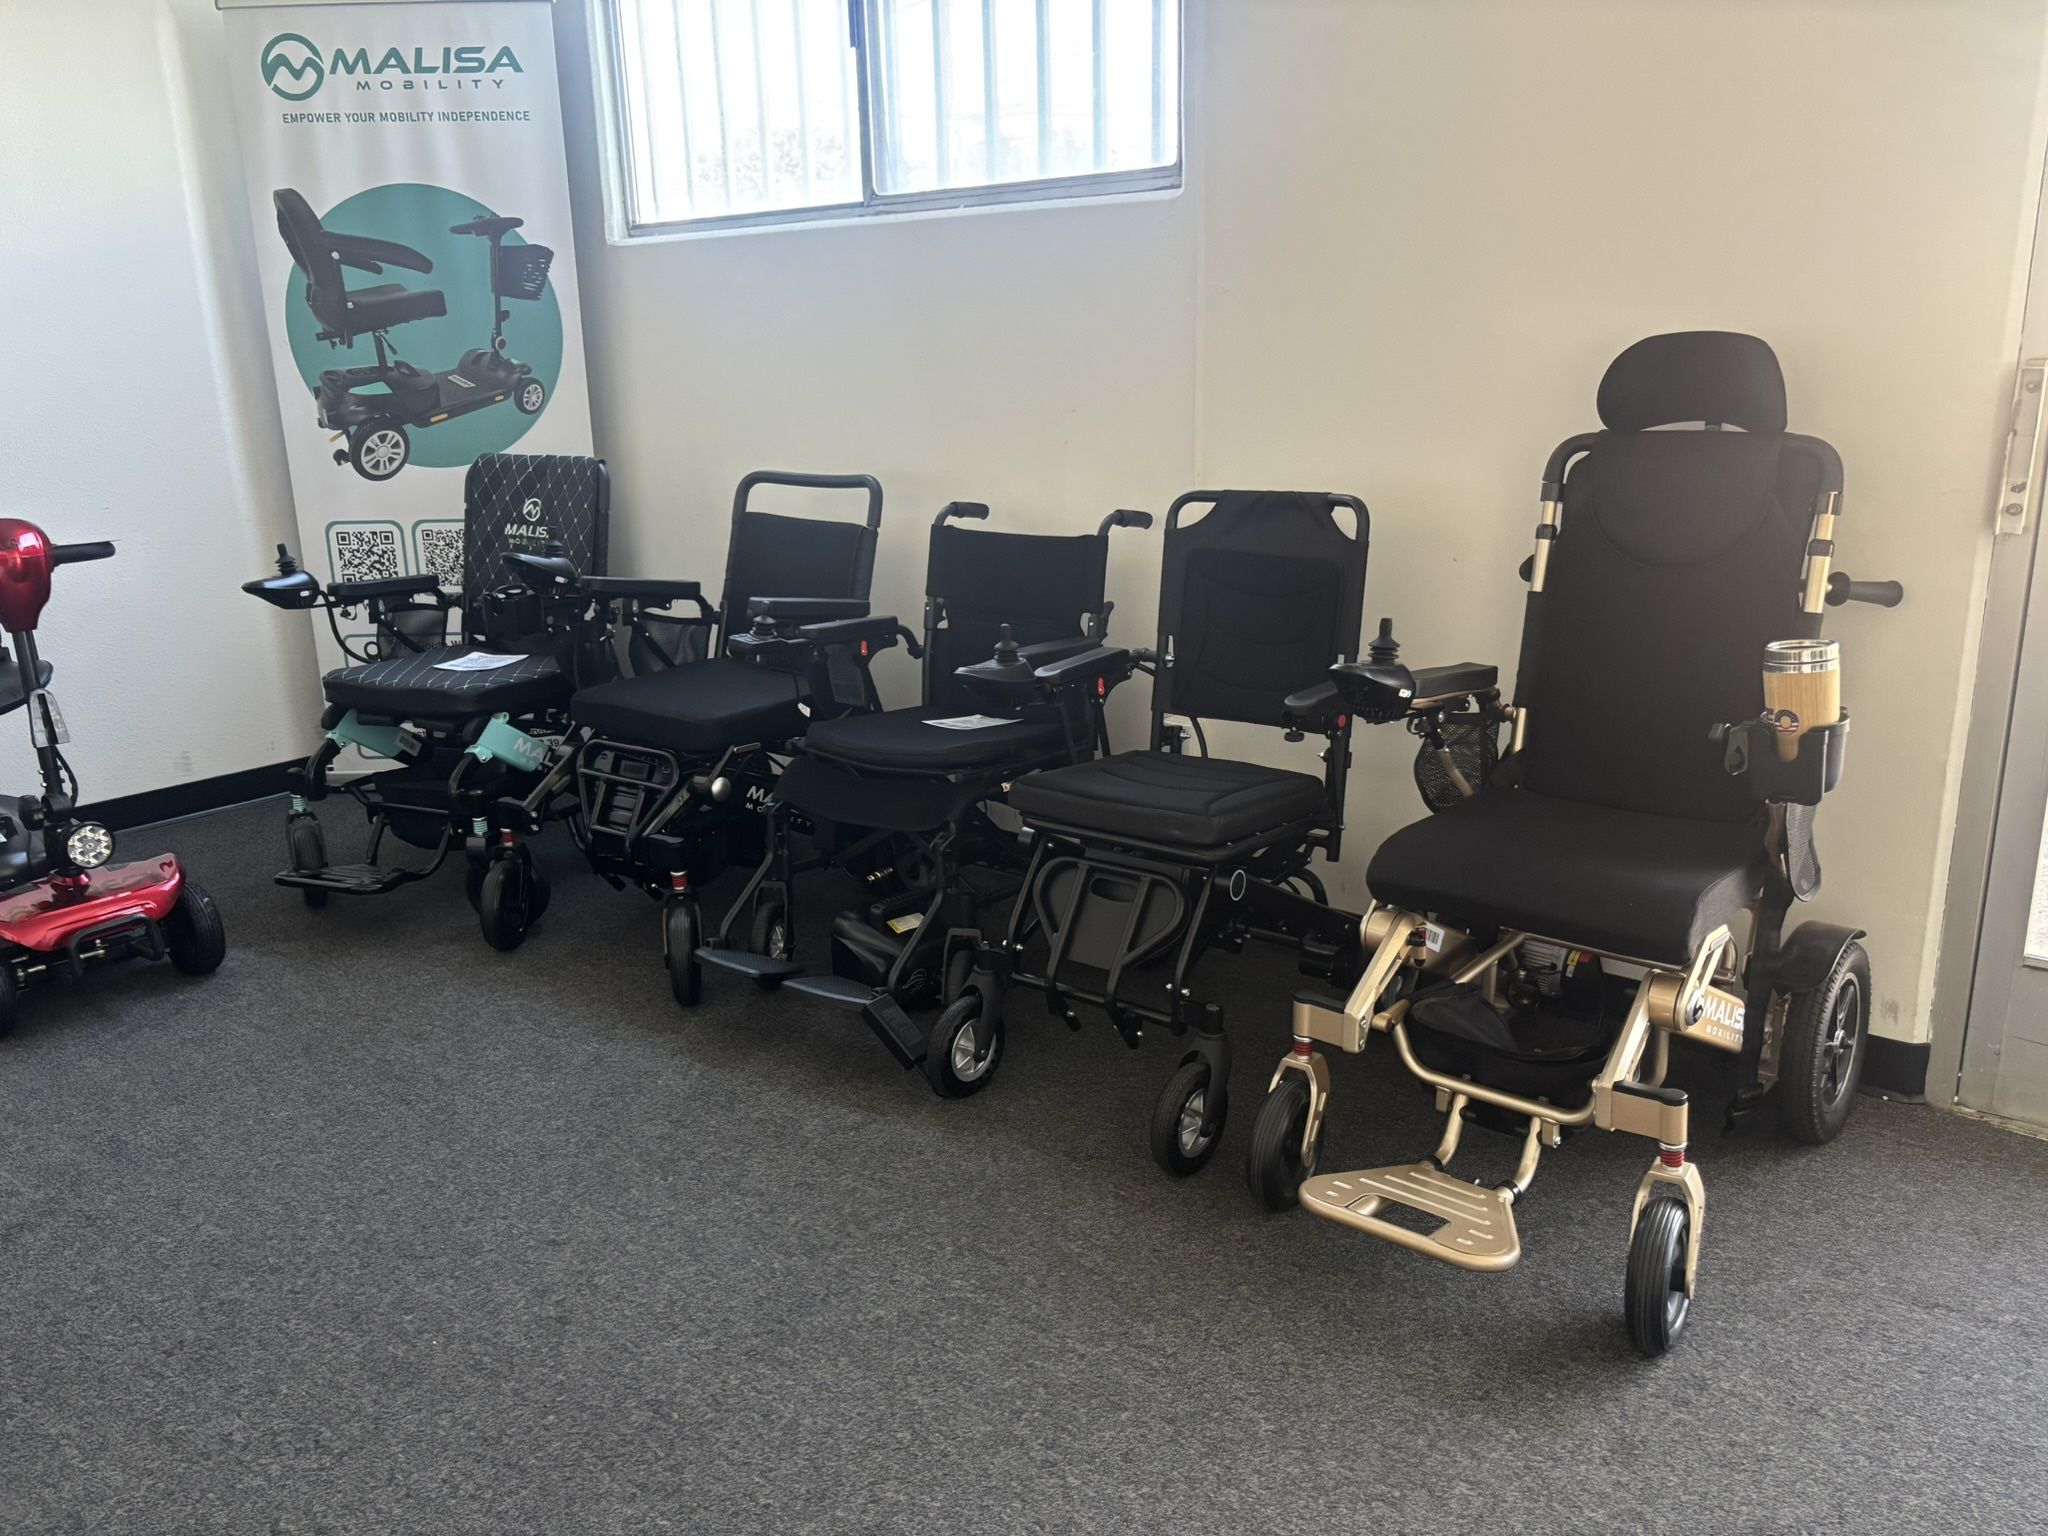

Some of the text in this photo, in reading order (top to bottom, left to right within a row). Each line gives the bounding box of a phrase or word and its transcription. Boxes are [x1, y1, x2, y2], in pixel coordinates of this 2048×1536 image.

[329, 45, 524, 75] MALISA
[356, 79, 504, 91] MOBILITY
[282, 110, 531, 124] EMPOWER YOUR MOBILITY INDEPENDENCE
[504, 522, 549, 539] MALIS
